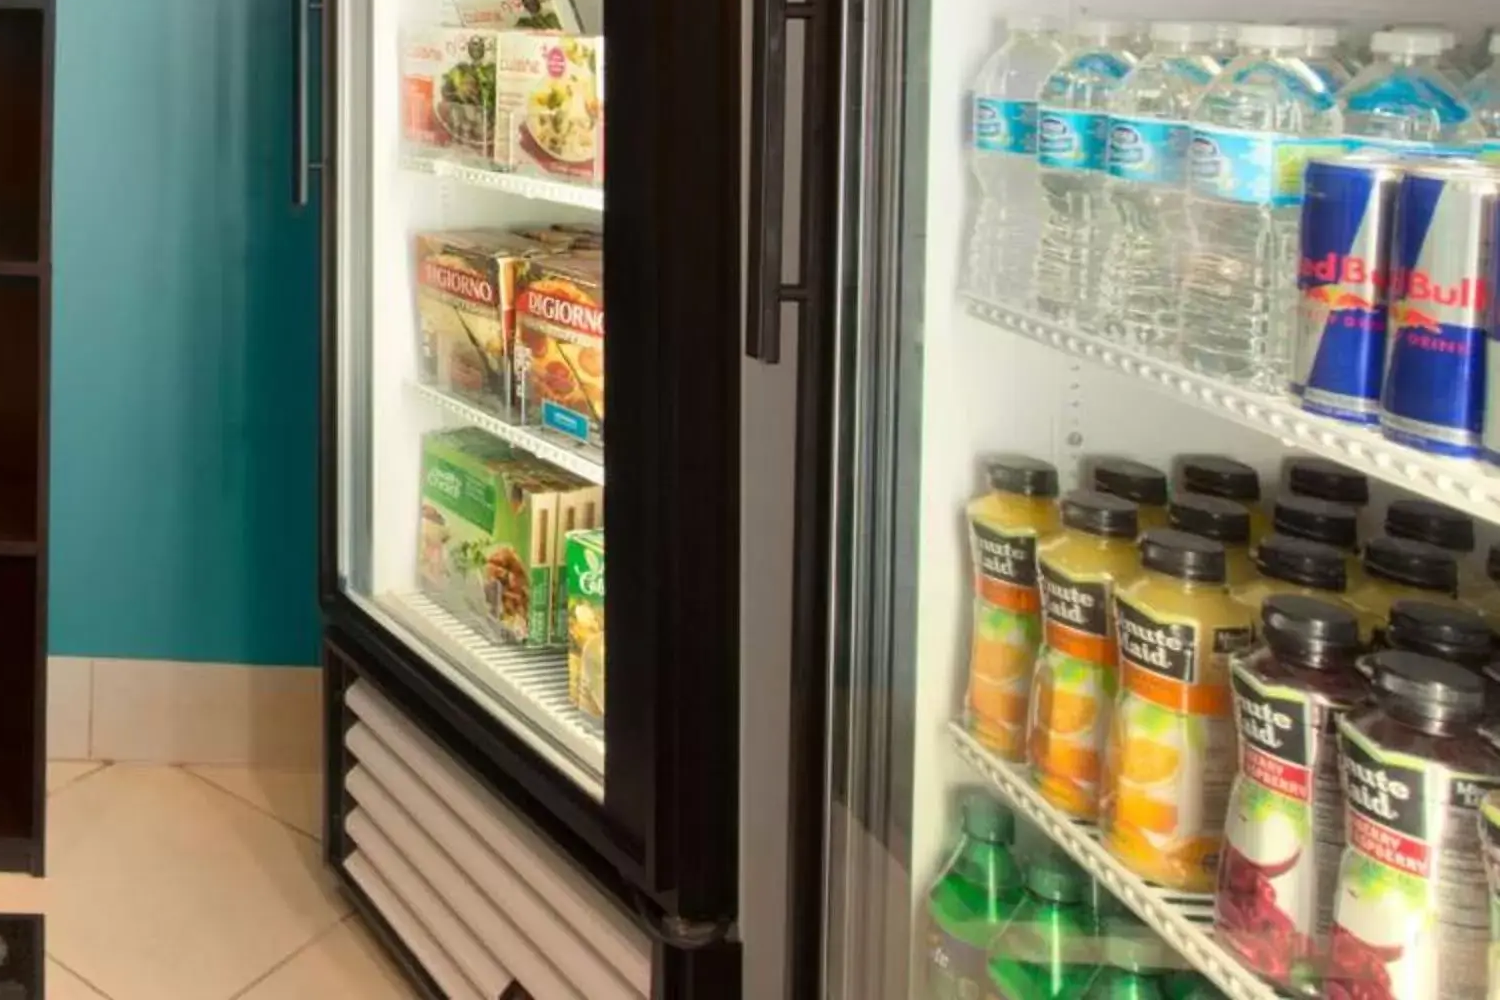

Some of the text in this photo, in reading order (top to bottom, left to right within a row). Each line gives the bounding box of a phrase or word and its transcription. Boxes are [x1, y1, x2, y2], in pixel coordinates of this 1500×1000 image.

[1410, 270, 1487, 312] Bull
[982, 557, 1014, 578] aid
[1050, 602, 1088, 625] aid
[1243, 720, 1284, 749] aid
[1349, 785, 1399, 821] aid
